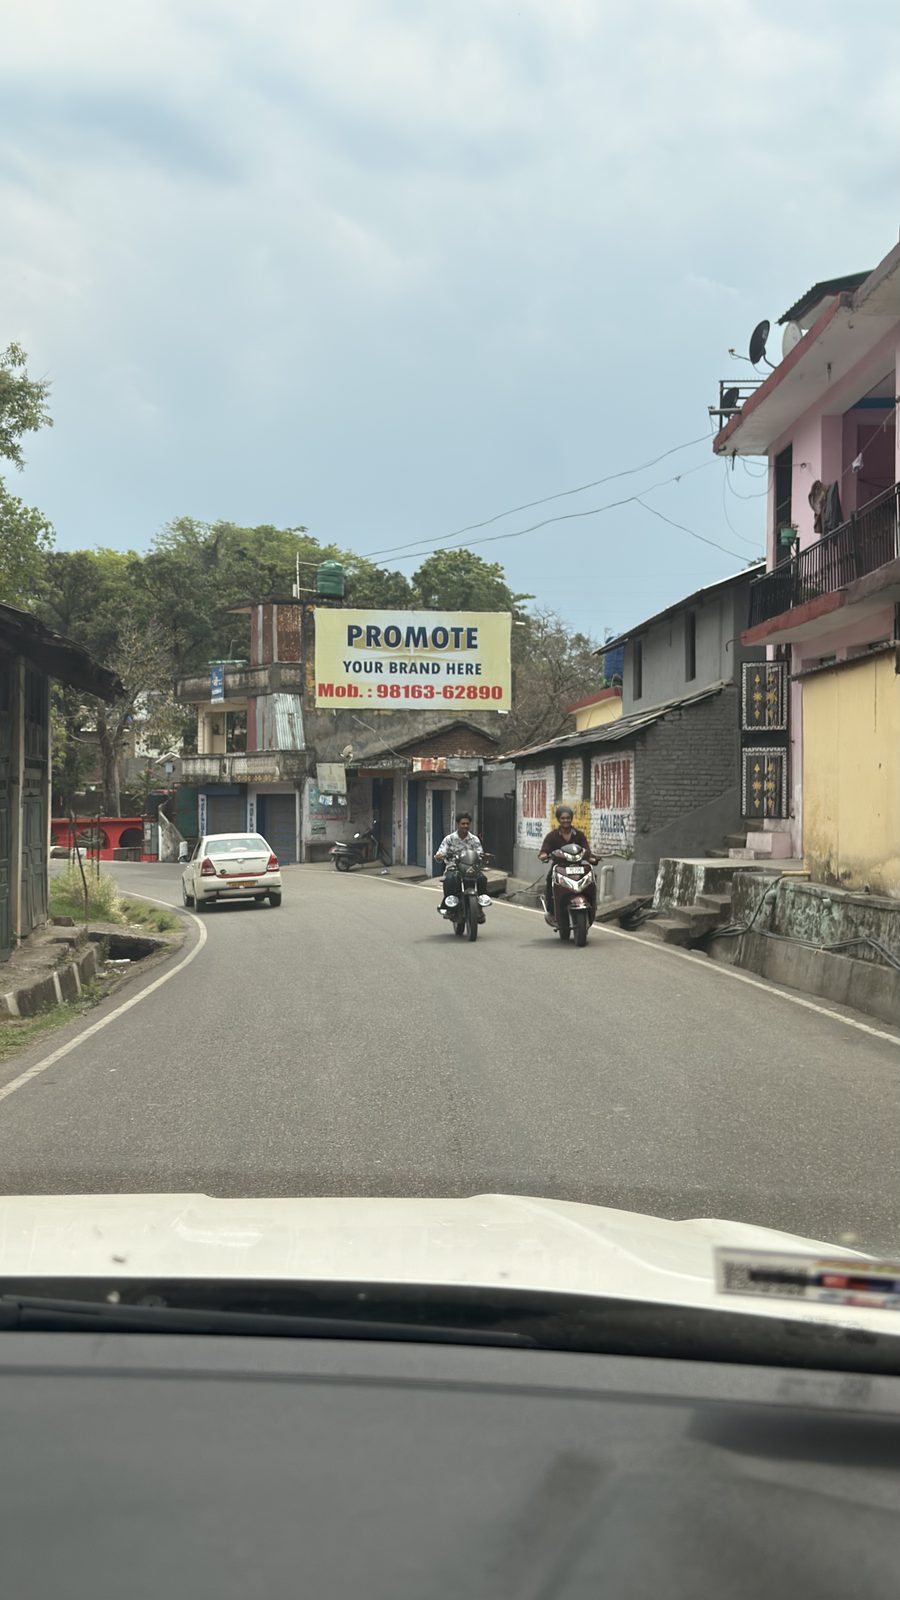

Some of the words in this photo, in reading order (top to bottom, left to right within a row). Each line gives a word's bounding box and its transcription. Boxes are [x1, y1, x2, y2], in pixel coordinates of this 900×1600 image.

[347, 624, 478, 649] PROMOTE
[343, 661, 383, 674] YOUR
[389, 662, 441, 675] BRAND
[446, 663, 482, 675] HERE
[376, 684, 503, 700] 98163-62890
